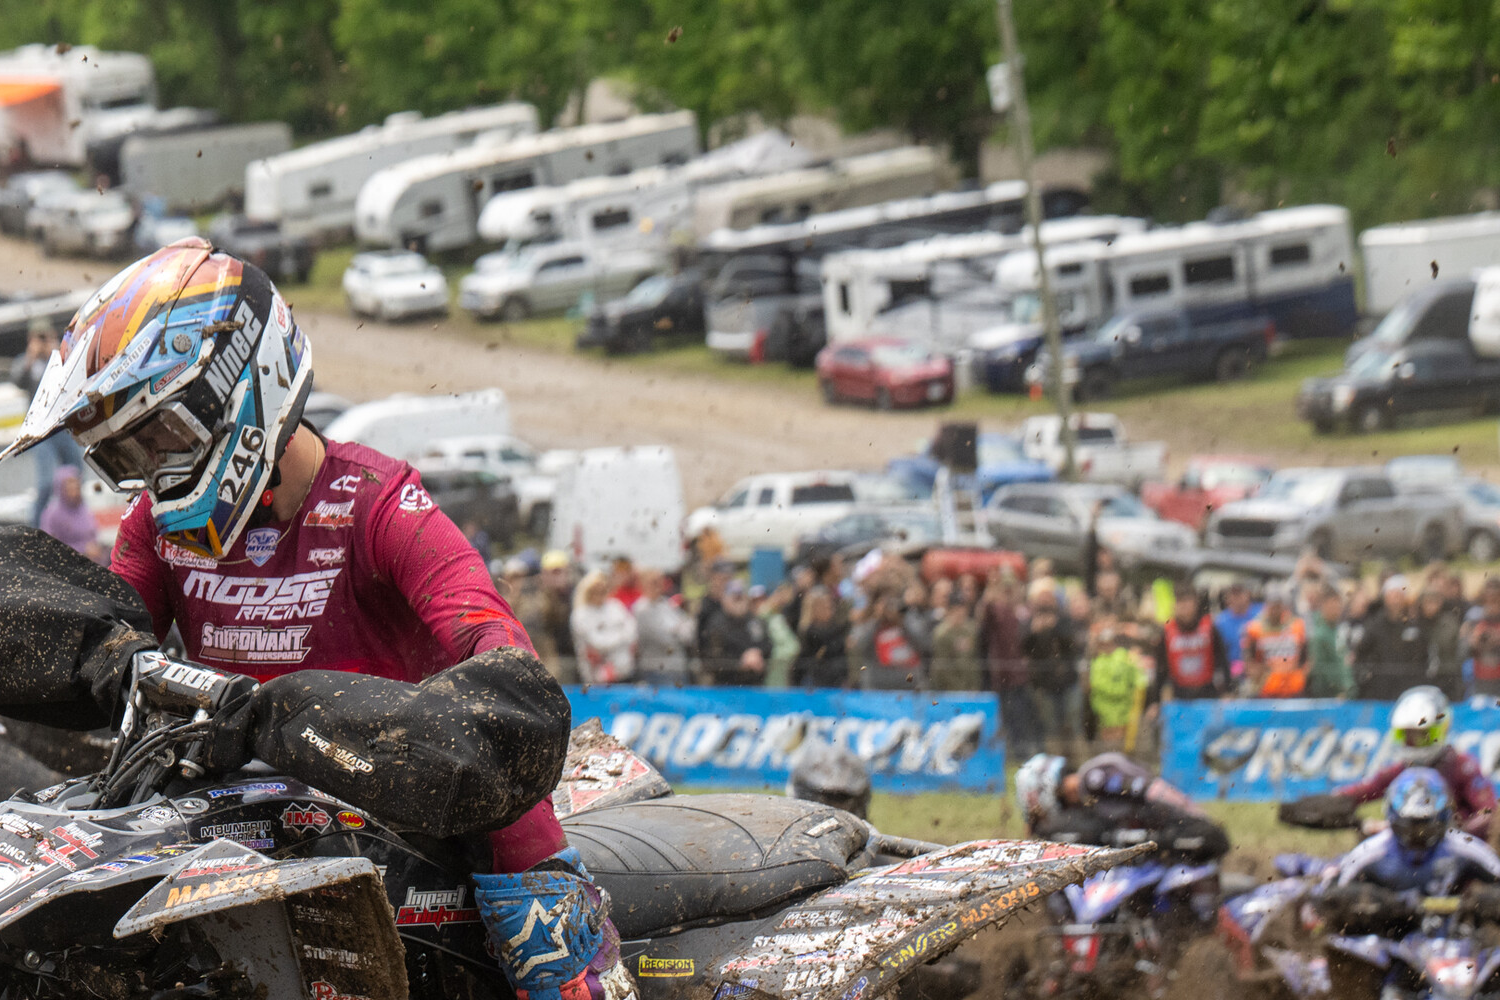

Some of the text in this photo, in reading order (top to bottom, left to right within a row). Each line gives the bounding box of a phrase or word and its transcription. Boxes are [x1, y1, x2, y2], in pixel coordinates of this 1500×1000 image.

[204, 300, 262, 404] Nine2
[220, 427, 265, 501] 246
[183, 568, 342, 605] MOOSE
[235, 599, 328, 621] RACING
[202, 623, 306, 651] STURDIVANT
[247, 652, 303, 661] POWERSPORTS
[201, 820, 271, 837] MOUNTAIN
[286, 811, 329, 826] IMS
[165, 868, 281, 909] MAXXIS
[405, 887, 466, 911] Impact
